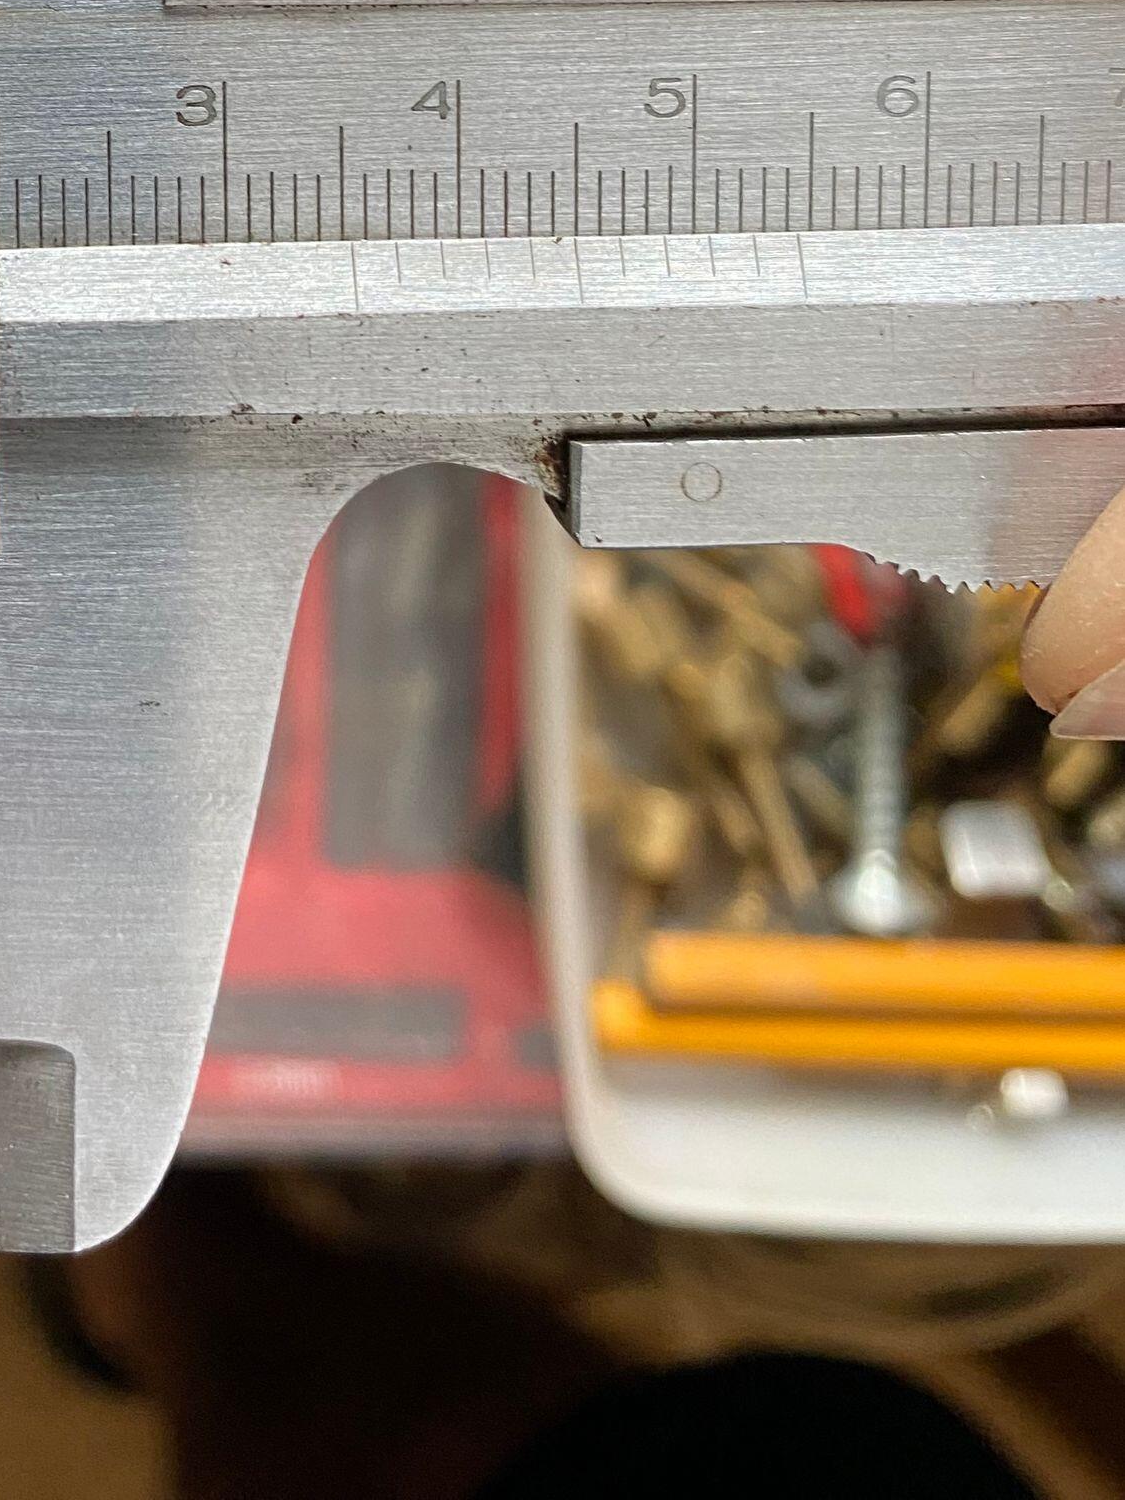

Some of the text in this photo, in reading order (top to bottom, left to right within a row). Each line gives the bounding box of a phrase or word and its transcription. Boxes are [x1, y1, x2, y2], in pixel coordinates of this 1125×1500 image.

[175, 84, 219, 127] 3
[410, 80, 452, 119] 4
[643, 77, 687, 118] 5
[875, 74, 920, 117] 6
